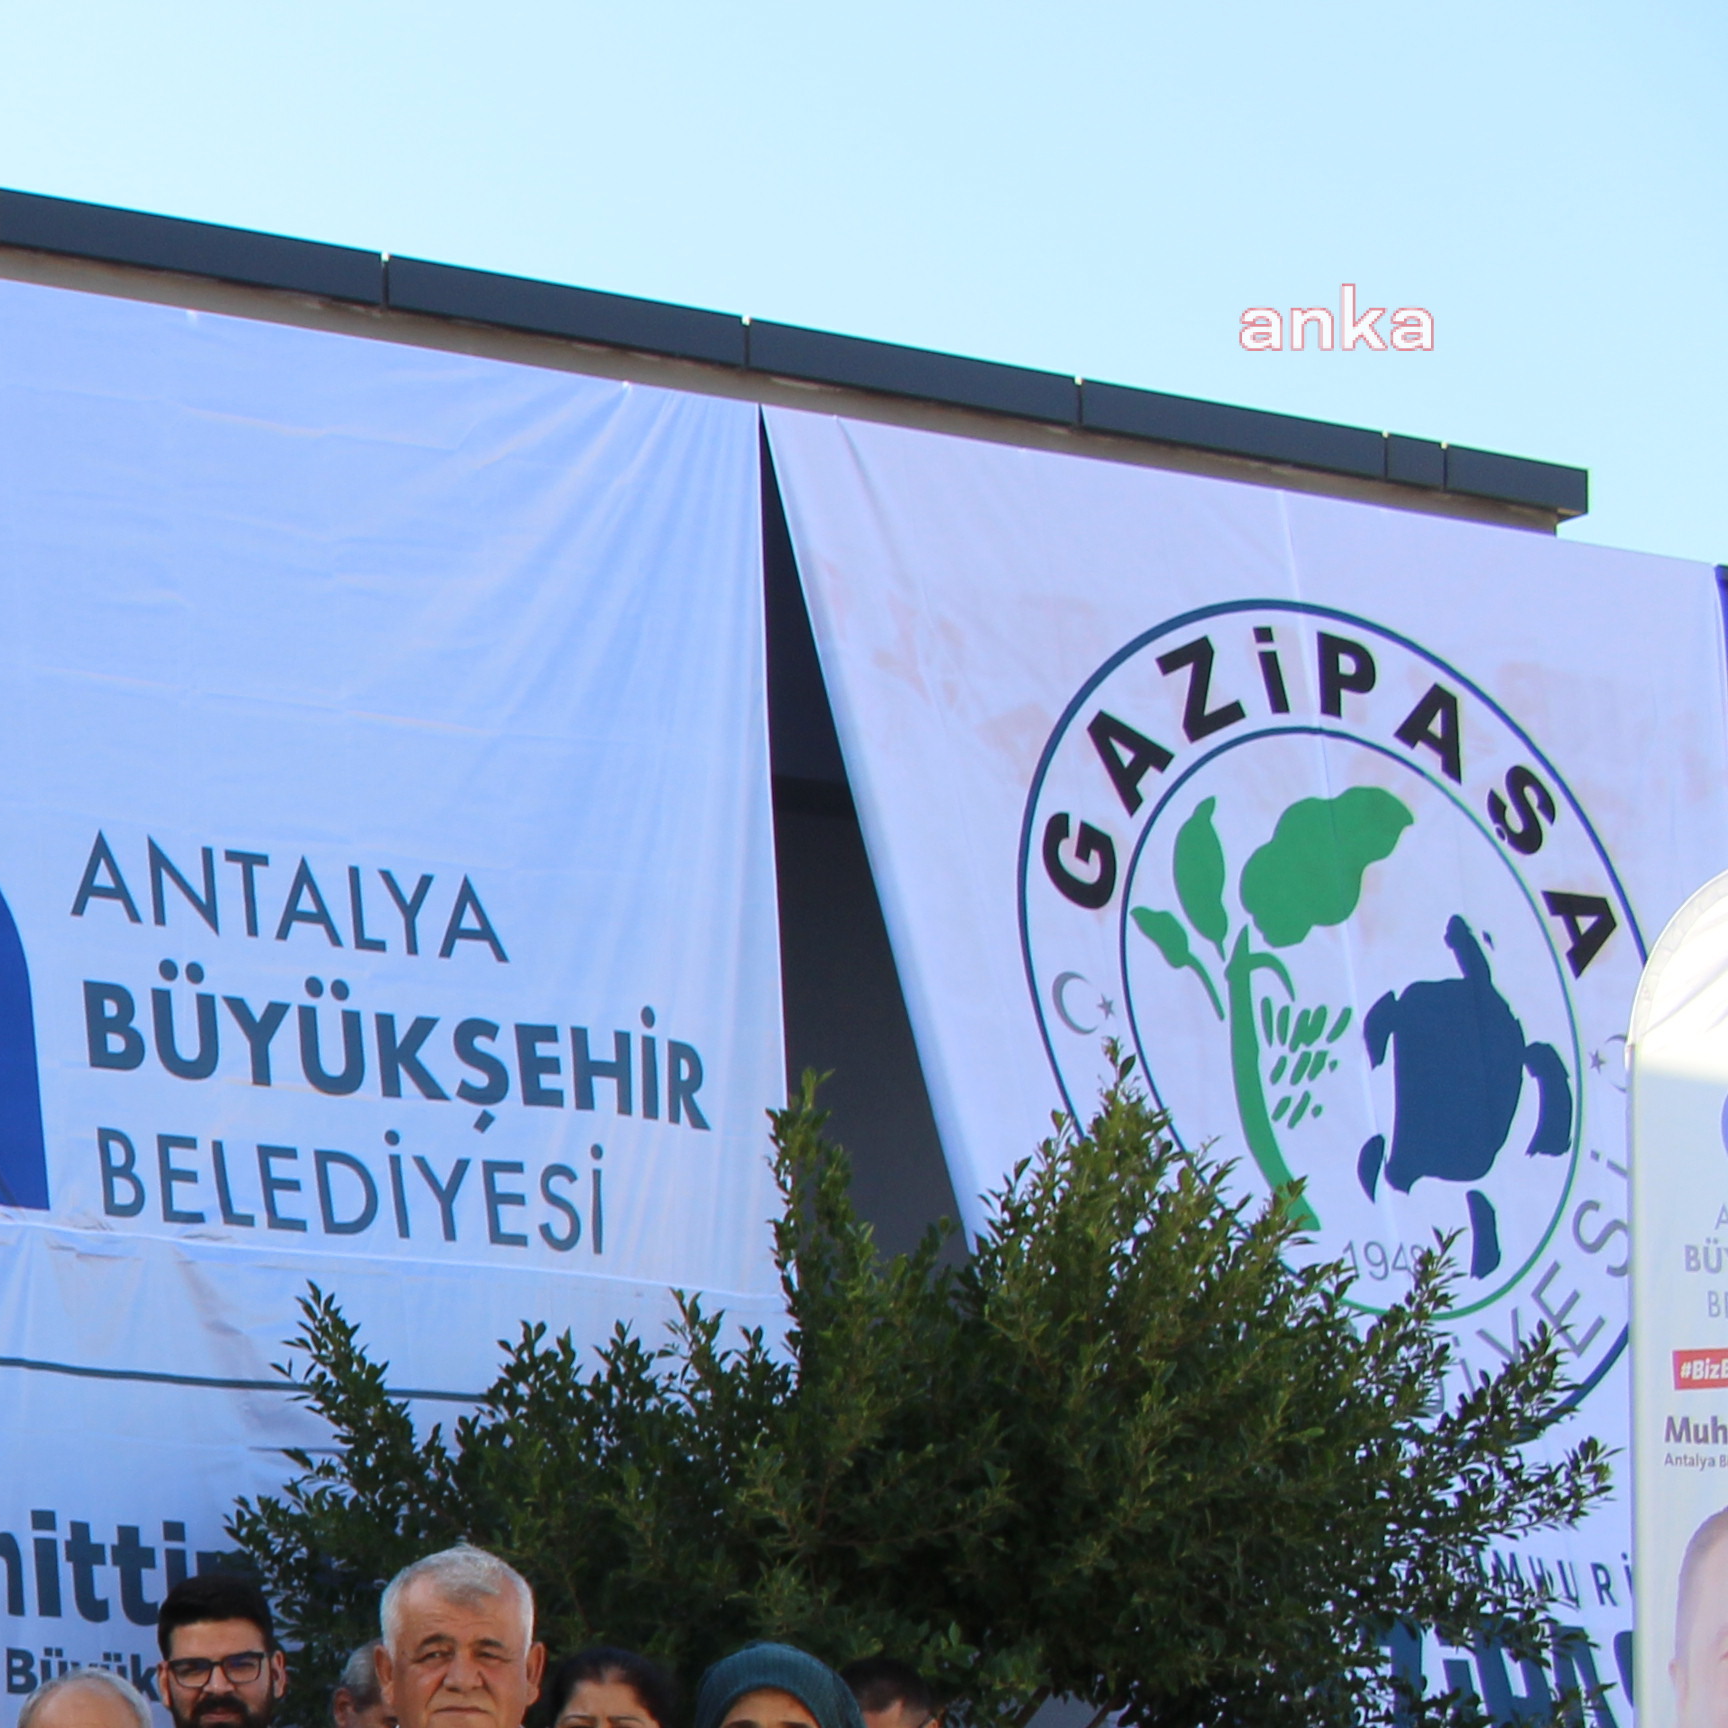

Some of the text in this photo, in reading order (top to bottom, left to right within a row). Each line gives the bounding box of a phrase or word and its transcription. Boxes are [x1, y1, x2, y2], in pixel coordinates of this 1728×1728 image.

[70, 828, 509, 963] ANTALYA
[82, 958, 711, 1133] BÜYÜKŞEHİR
[97, 1127, 605, 1256] BELEDİYESİ
[1664, 1452, 1716, 1471] Antalya
